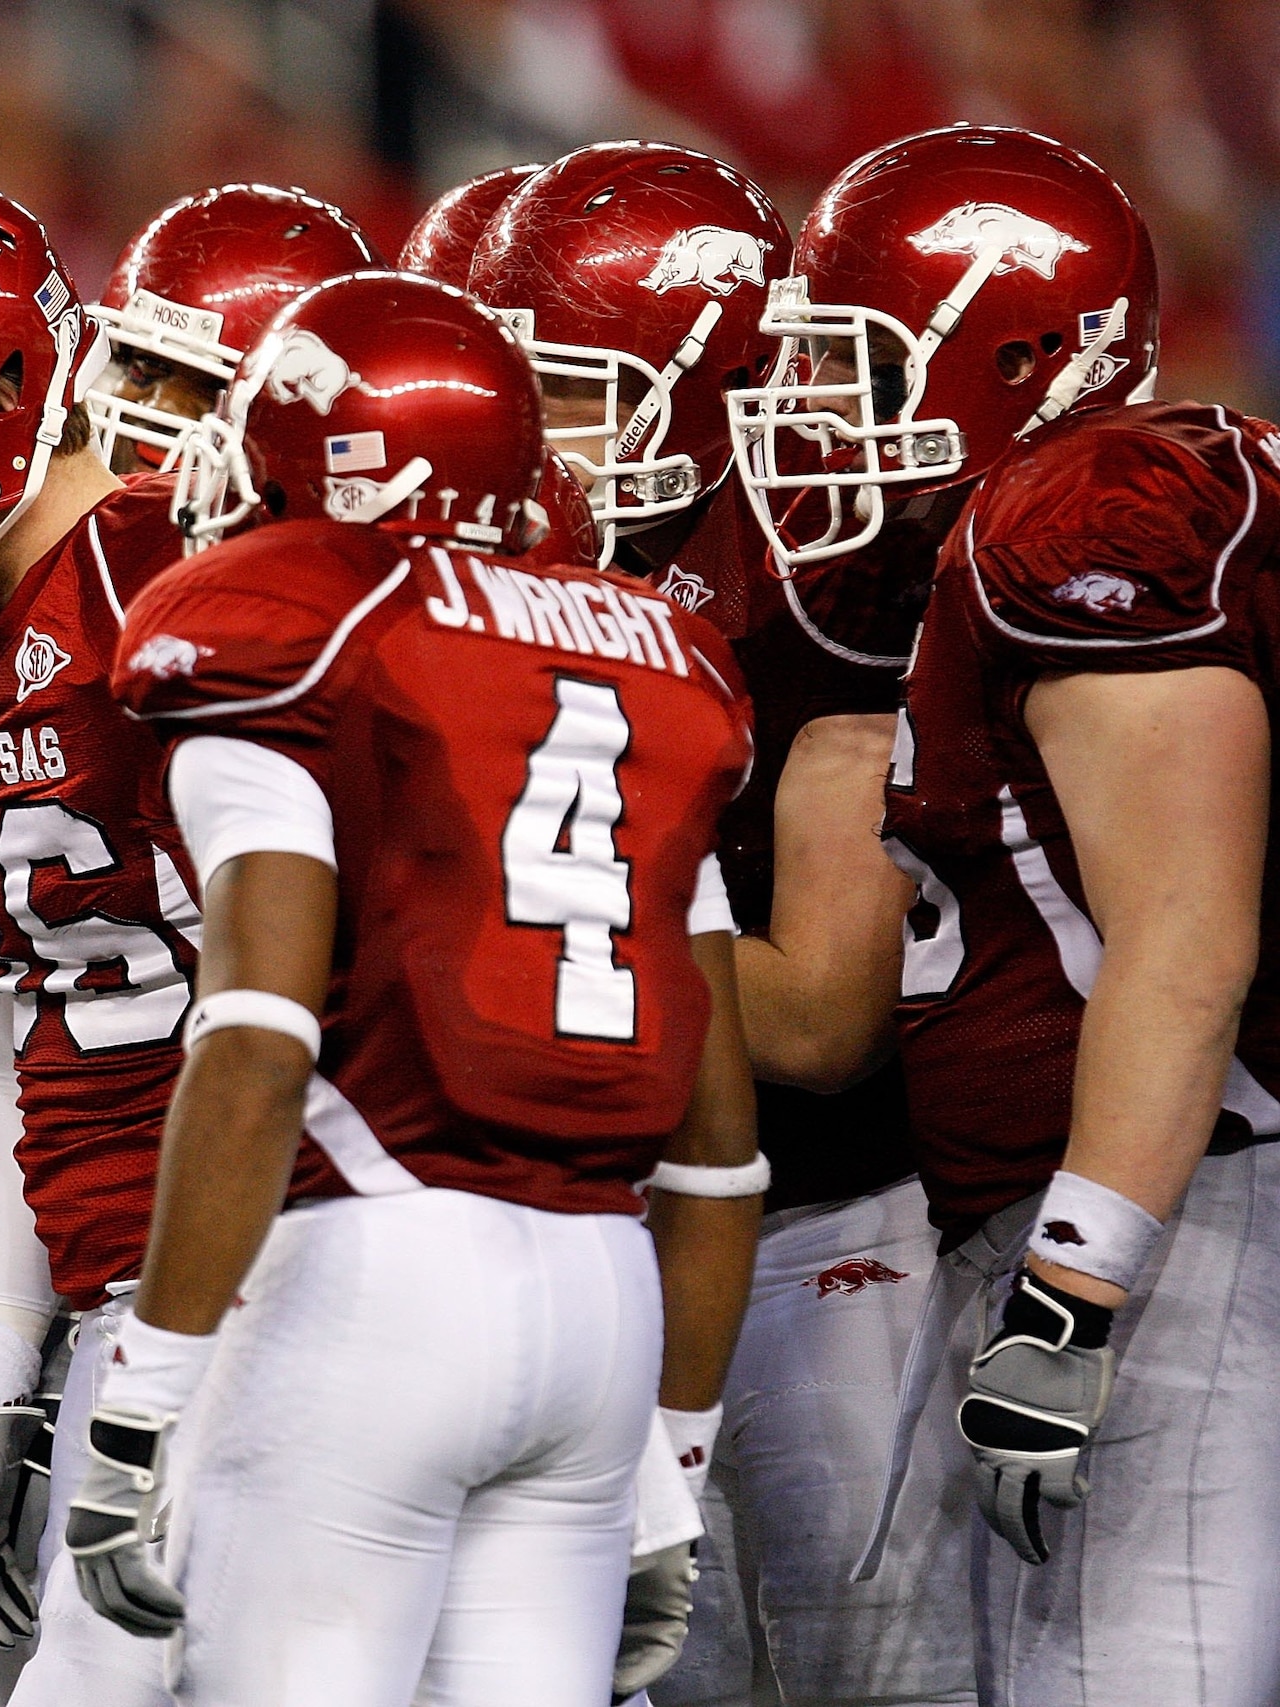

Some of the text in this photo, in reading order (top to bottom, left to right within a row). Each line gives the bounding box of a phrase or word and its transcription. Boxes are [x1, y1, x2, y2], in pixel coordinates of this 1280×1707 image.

[153, 304, 189, 330] HOGS
[425, 546, 689, 678] J.WRIGHT
[29, 644, 48, 680] SEC
[503, 674, 637, 1044] 4
